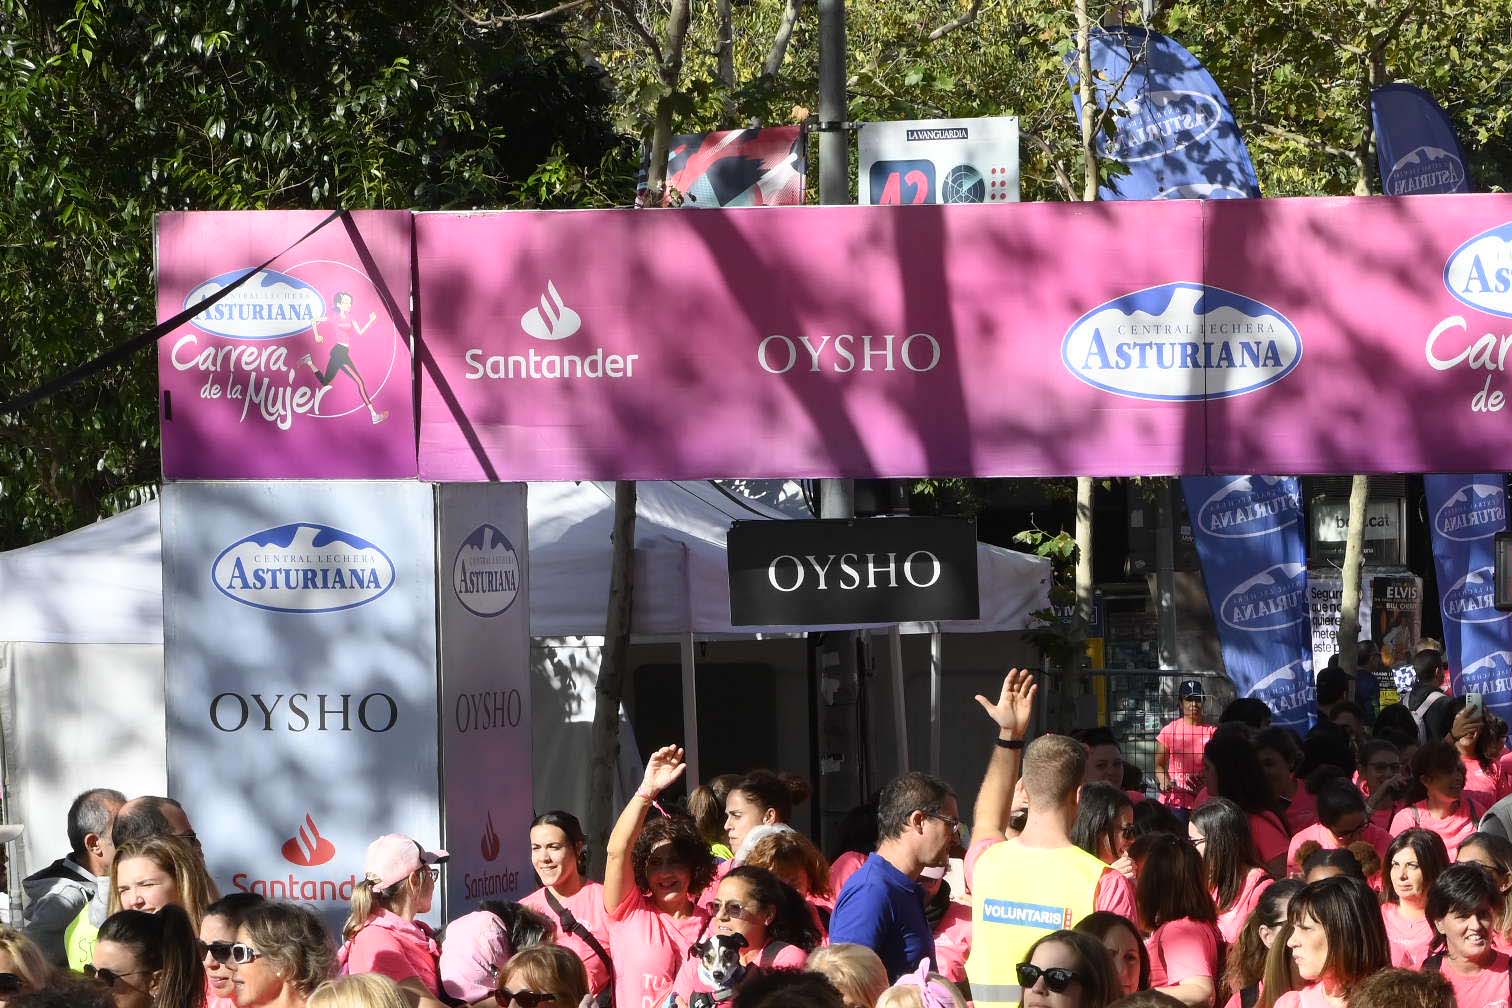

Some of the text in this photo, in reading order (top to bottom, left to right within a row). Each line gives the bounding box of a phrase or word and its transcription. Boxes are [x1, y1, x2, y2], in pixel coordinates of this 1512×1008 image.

[917, 130, 967, 140] VANGUARDIA
[1117, 323, 1194, 335] CENTRAL
[171, 334, 289, 371] Carrera
[465, 348, 639, 380] Santander
[757, 333, 942, 375] OYSHO
[1082, 327, 1283, 369] ASTURIANA
[201, 369, 333, 430] de la Mujer
[1471, 374, 1506, 413] de
[227, 557, 382, 590] ASTURIANA
[254, 554, 376, 563] CENTRAL LECHERA
[768, 551, 941, 592] OYSHO
[459, 562, 516, 594] ASTURIANA
[1386, 586, 1417, 599] ELVIS
[1312, 602, 1329, 614] que
[209, 692, 398, 733] OYSHO
[455, 689, 522, 734] OYSHO
[464, 869, 520, 900] Santander
